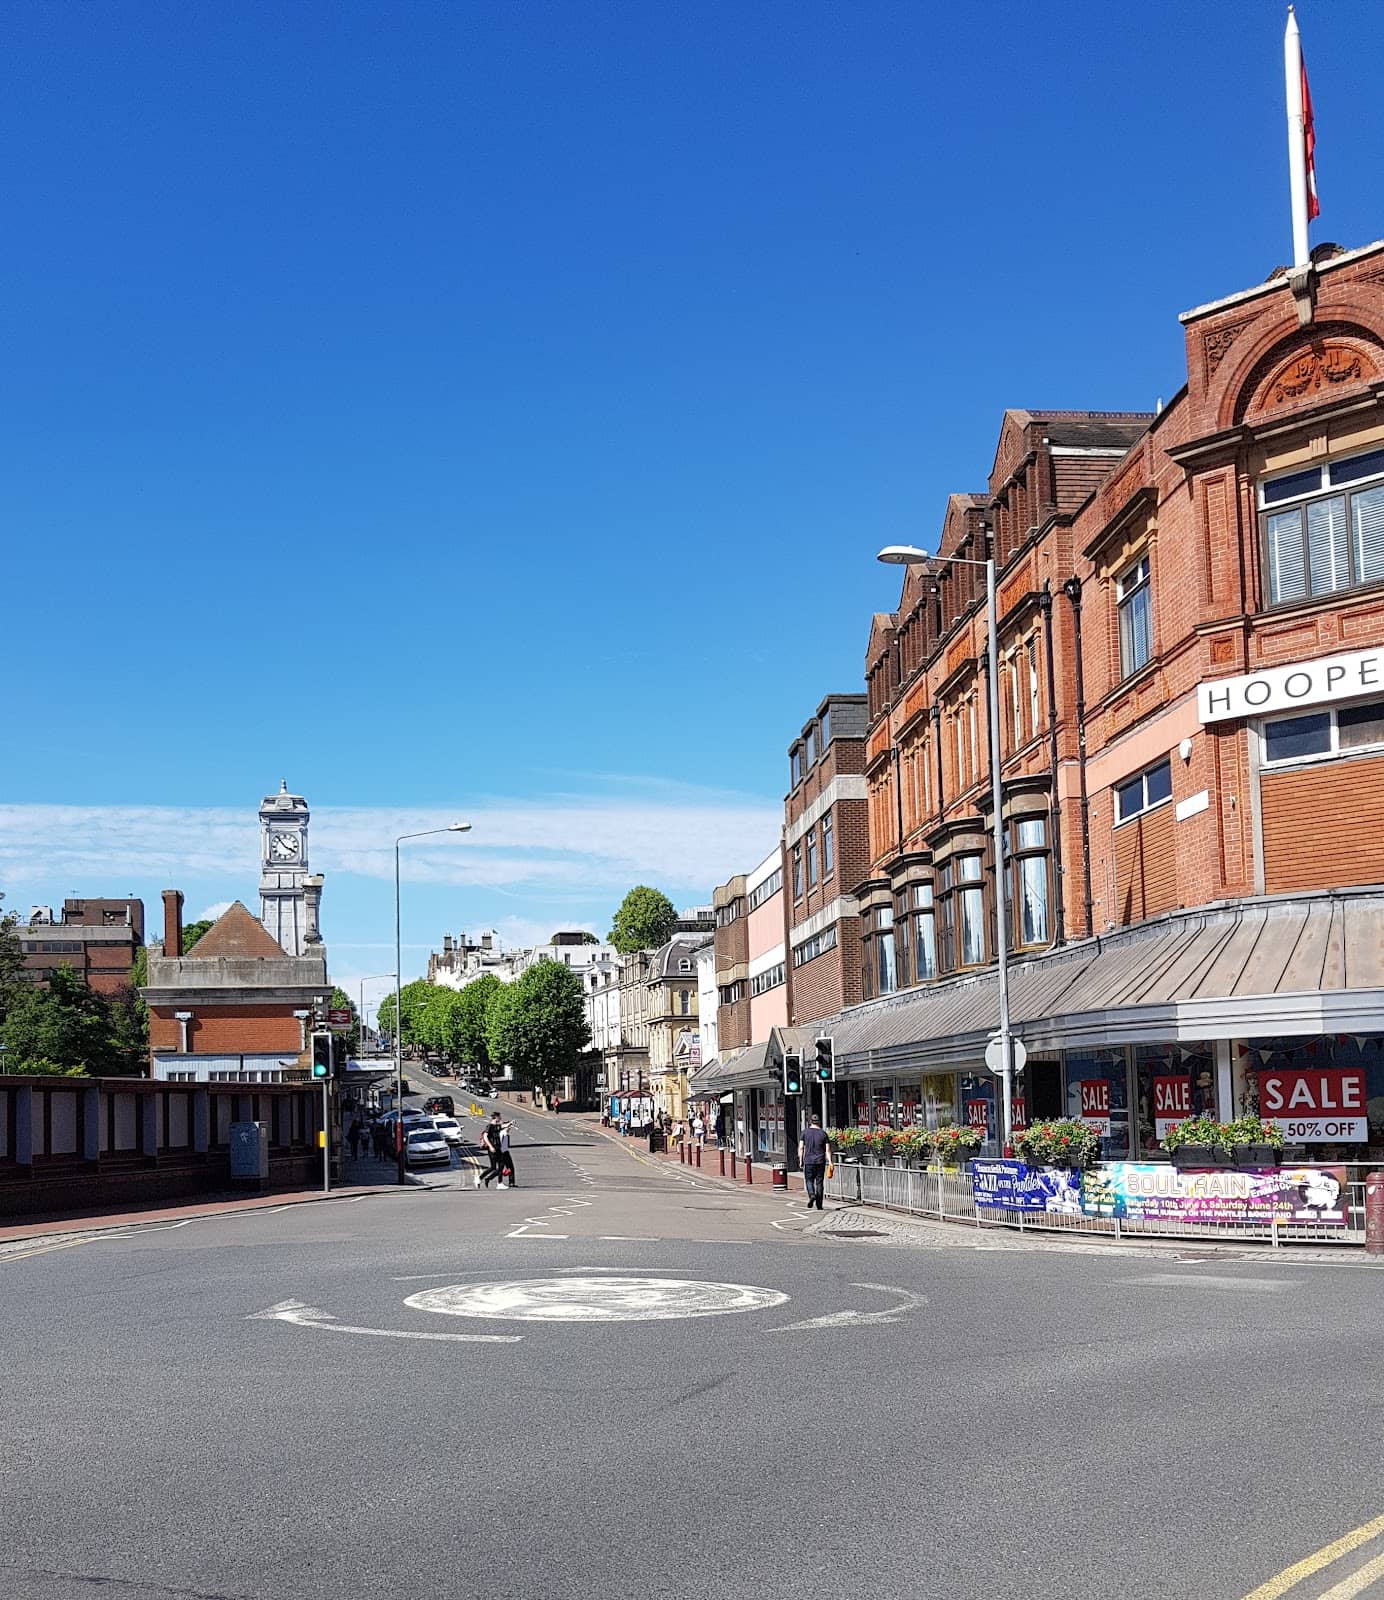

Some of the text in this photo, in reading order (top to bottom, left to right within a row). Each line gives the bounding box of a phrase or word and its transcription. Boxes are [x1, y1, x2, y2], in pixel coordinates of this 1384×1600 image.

[1208, 657, 1379, 714] HOOPE
[1082, 1085, 1109, 1111] SALE
[1156, 1082, 1190, 1111] SALE
[1265, 1076, 1361, 1110] SALE
[968, 1104, 988, 1125] SALE
[1287, 1122, 1322, 1137] 50%
[1209, 1201, 1247, 1211] Saturday
[1249, 1202, 1271, 1210] June
[1273, 1202, 1294, 1210] 24th
